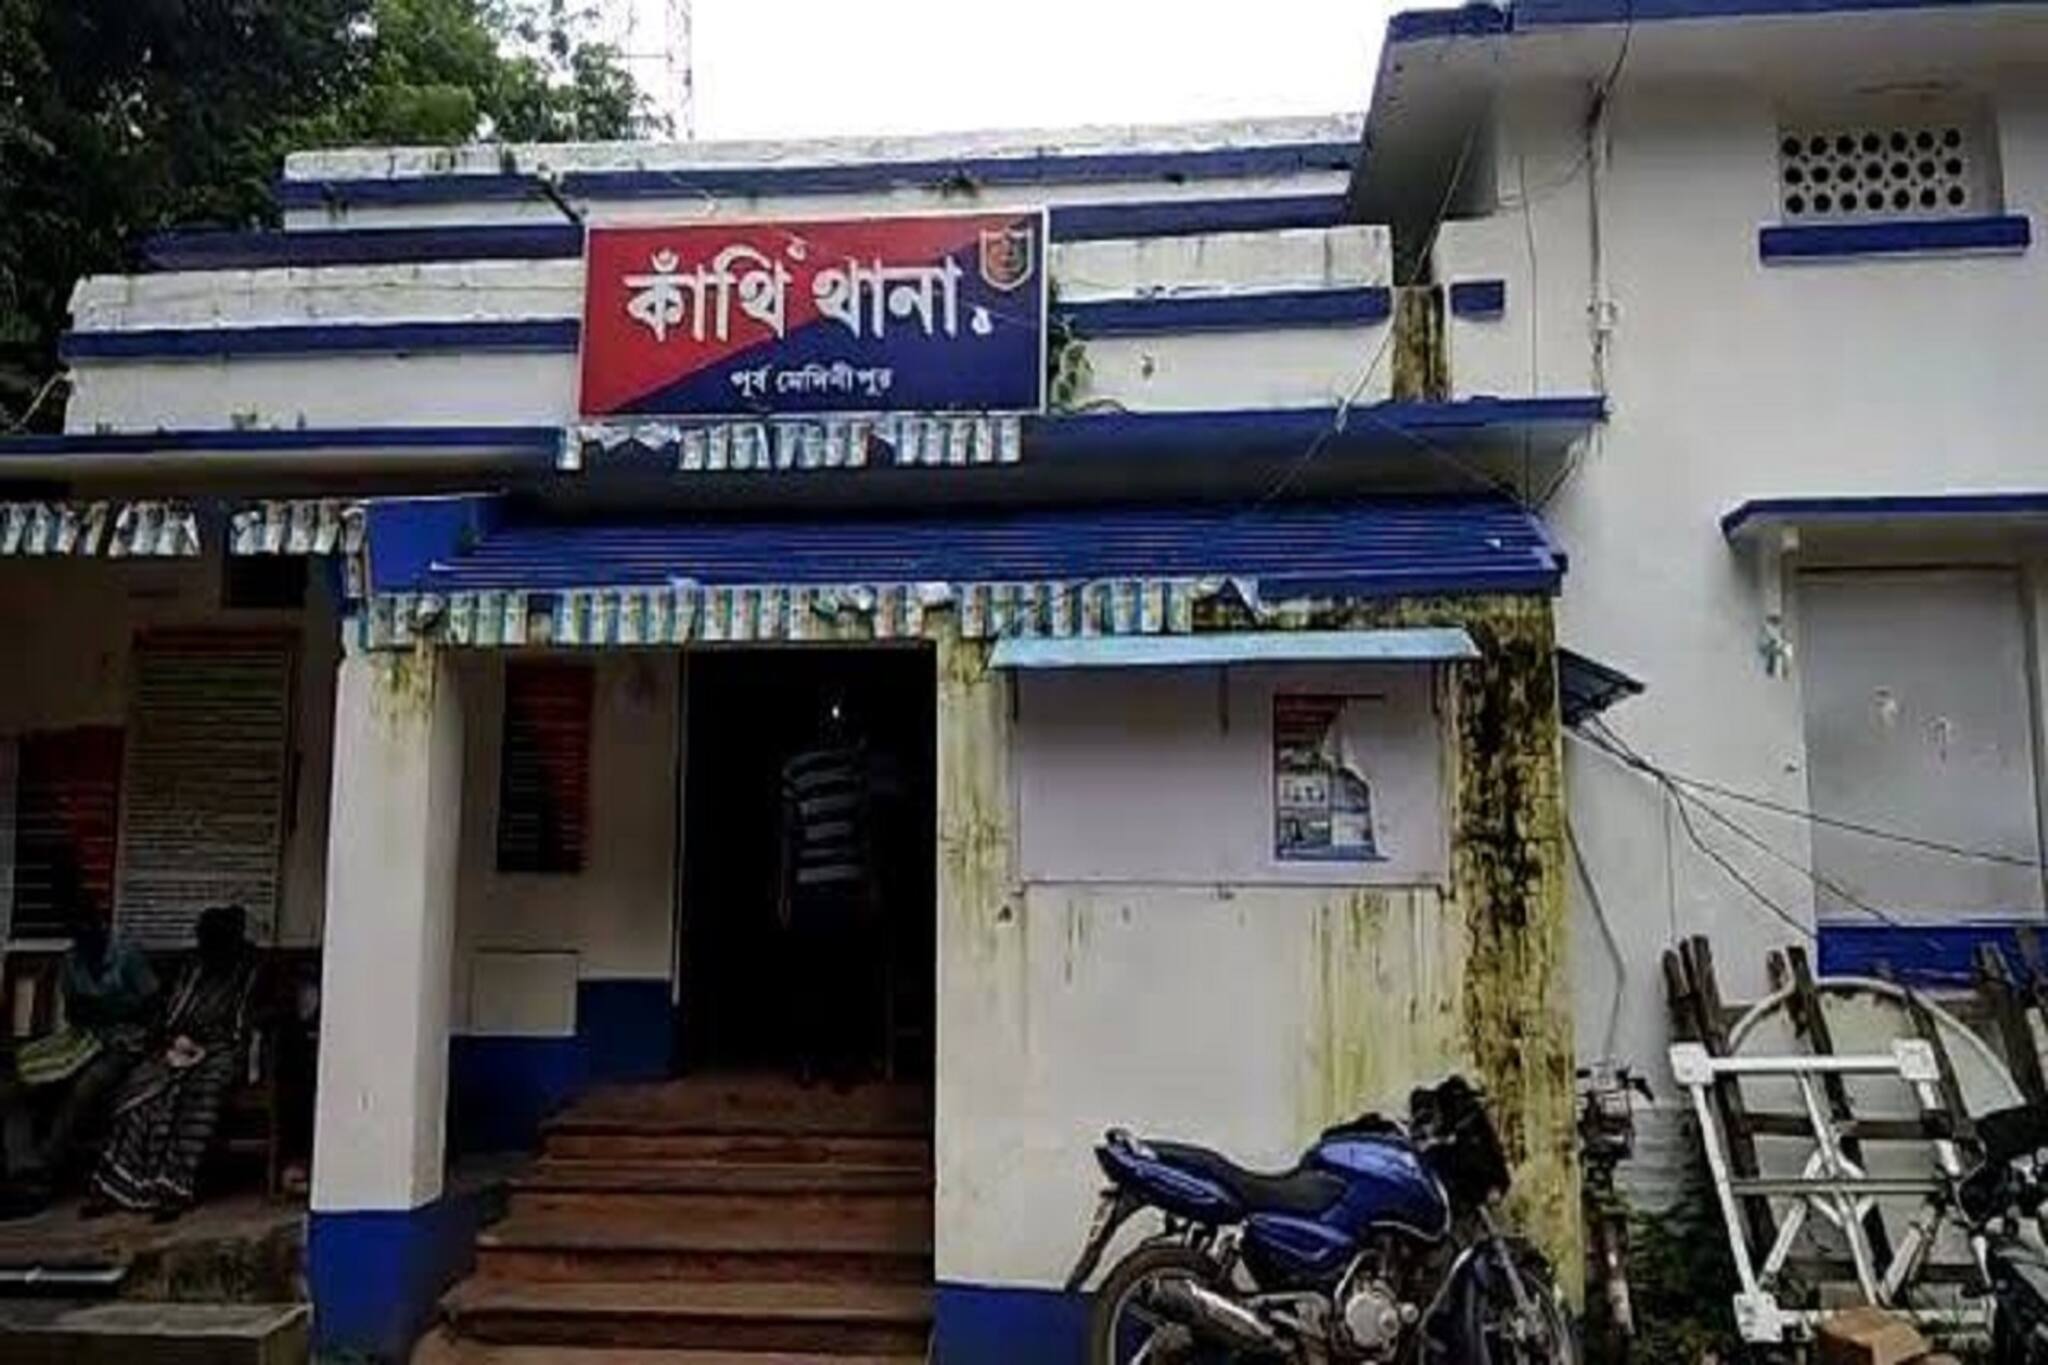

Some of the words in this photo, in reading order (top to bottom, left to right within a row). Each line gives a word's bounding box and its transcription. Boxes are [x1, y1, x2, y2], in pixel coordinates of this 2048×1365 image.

[622, 243, 793, 342] কাঁথি
[812, 255, 963, 338] থানা
[730, 364, 773, 397] পূর্ব
